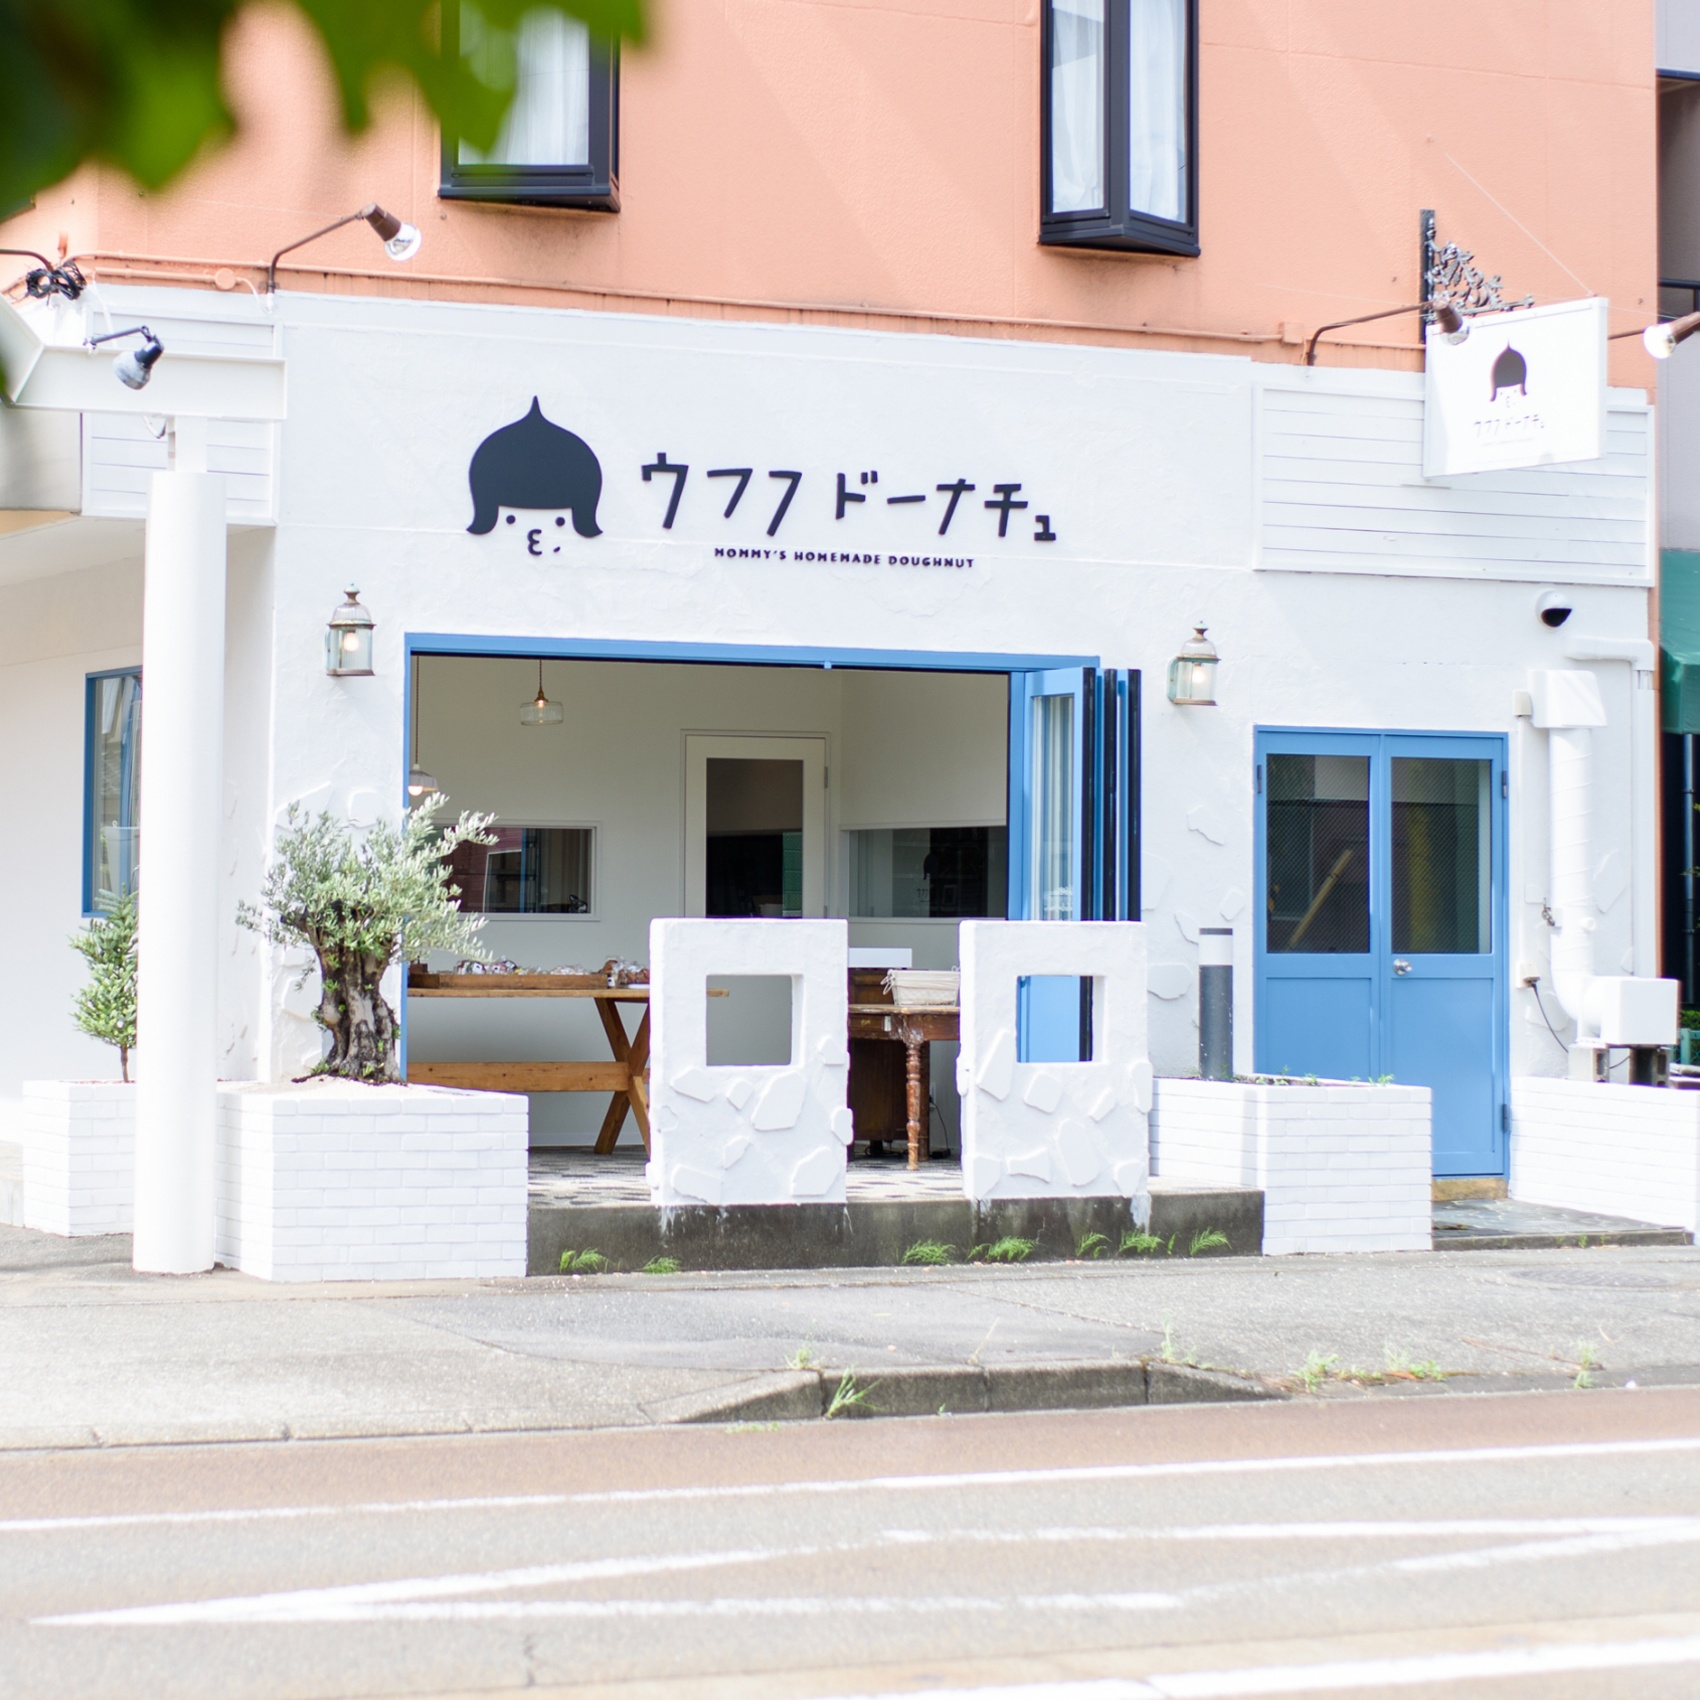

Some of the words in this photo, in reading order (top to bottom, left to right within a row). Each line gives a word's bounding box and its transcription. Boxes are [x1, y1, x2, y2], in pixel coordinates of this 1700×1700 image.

[641, 452, 803, 537] ウフフ
[835, 470, 1057, 542] ドーナチュ
[715, 548, 787, 561] MOMMY'S
[794, 551, 881, 566] HOMEMADE
[888, 555, 974, 568] DOUGHNUT
